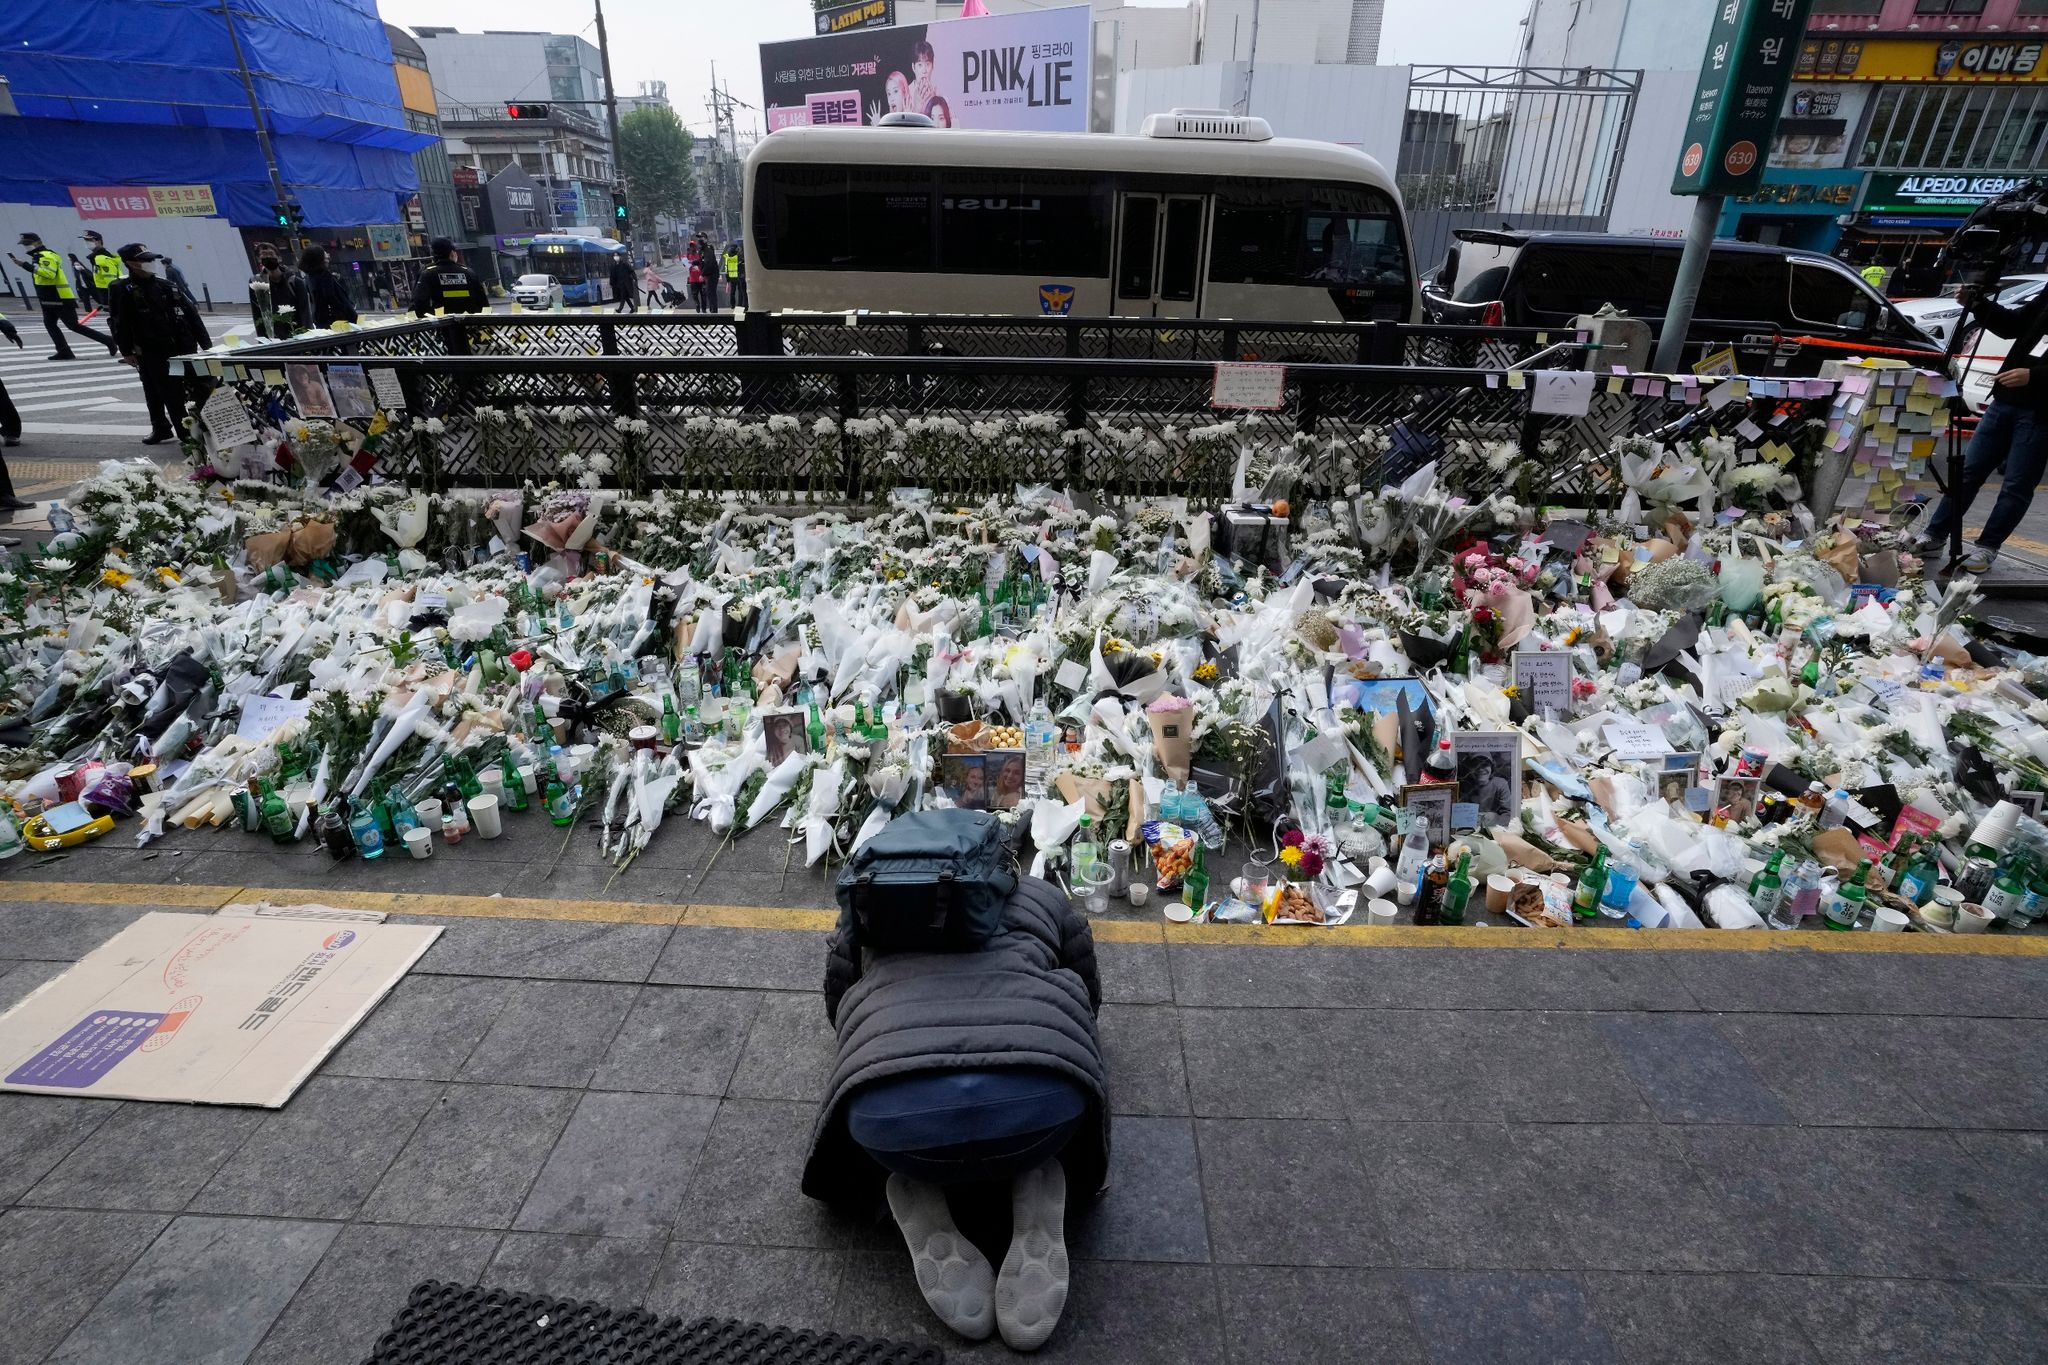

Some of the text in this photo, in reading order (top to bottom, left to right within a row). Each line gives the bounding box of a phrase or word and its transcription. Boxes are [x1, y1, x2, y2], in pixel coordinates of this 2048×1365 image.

[831, 1, 886, 31] LATIN PUB
[1031, 41, 1073, 59] 핑크라이
[1963, 44, 2042, 73] 이바돔
[774, 61, 877, 84] 사랑을 위한 단 하나의 거짓말
[962, 46, 1026, 94] PINK
[1026, 60, 1073, 107] LIE
[1745, 84, 1773, 94] Itaewon
[1701, 88, 1718, 100] Itaewon
[811, 99, 857, 124] 클럽은
[1684, 153, 1700, 167] 630
[1728, 152, 1752, 165] 630
[1897, 177, 2026, 194] ALPEDO KEBA
[77, 196, 112, 211] 임대
[546, 245, 565, 254] 421
[238, 966, 323, 1031] 밴드골드
